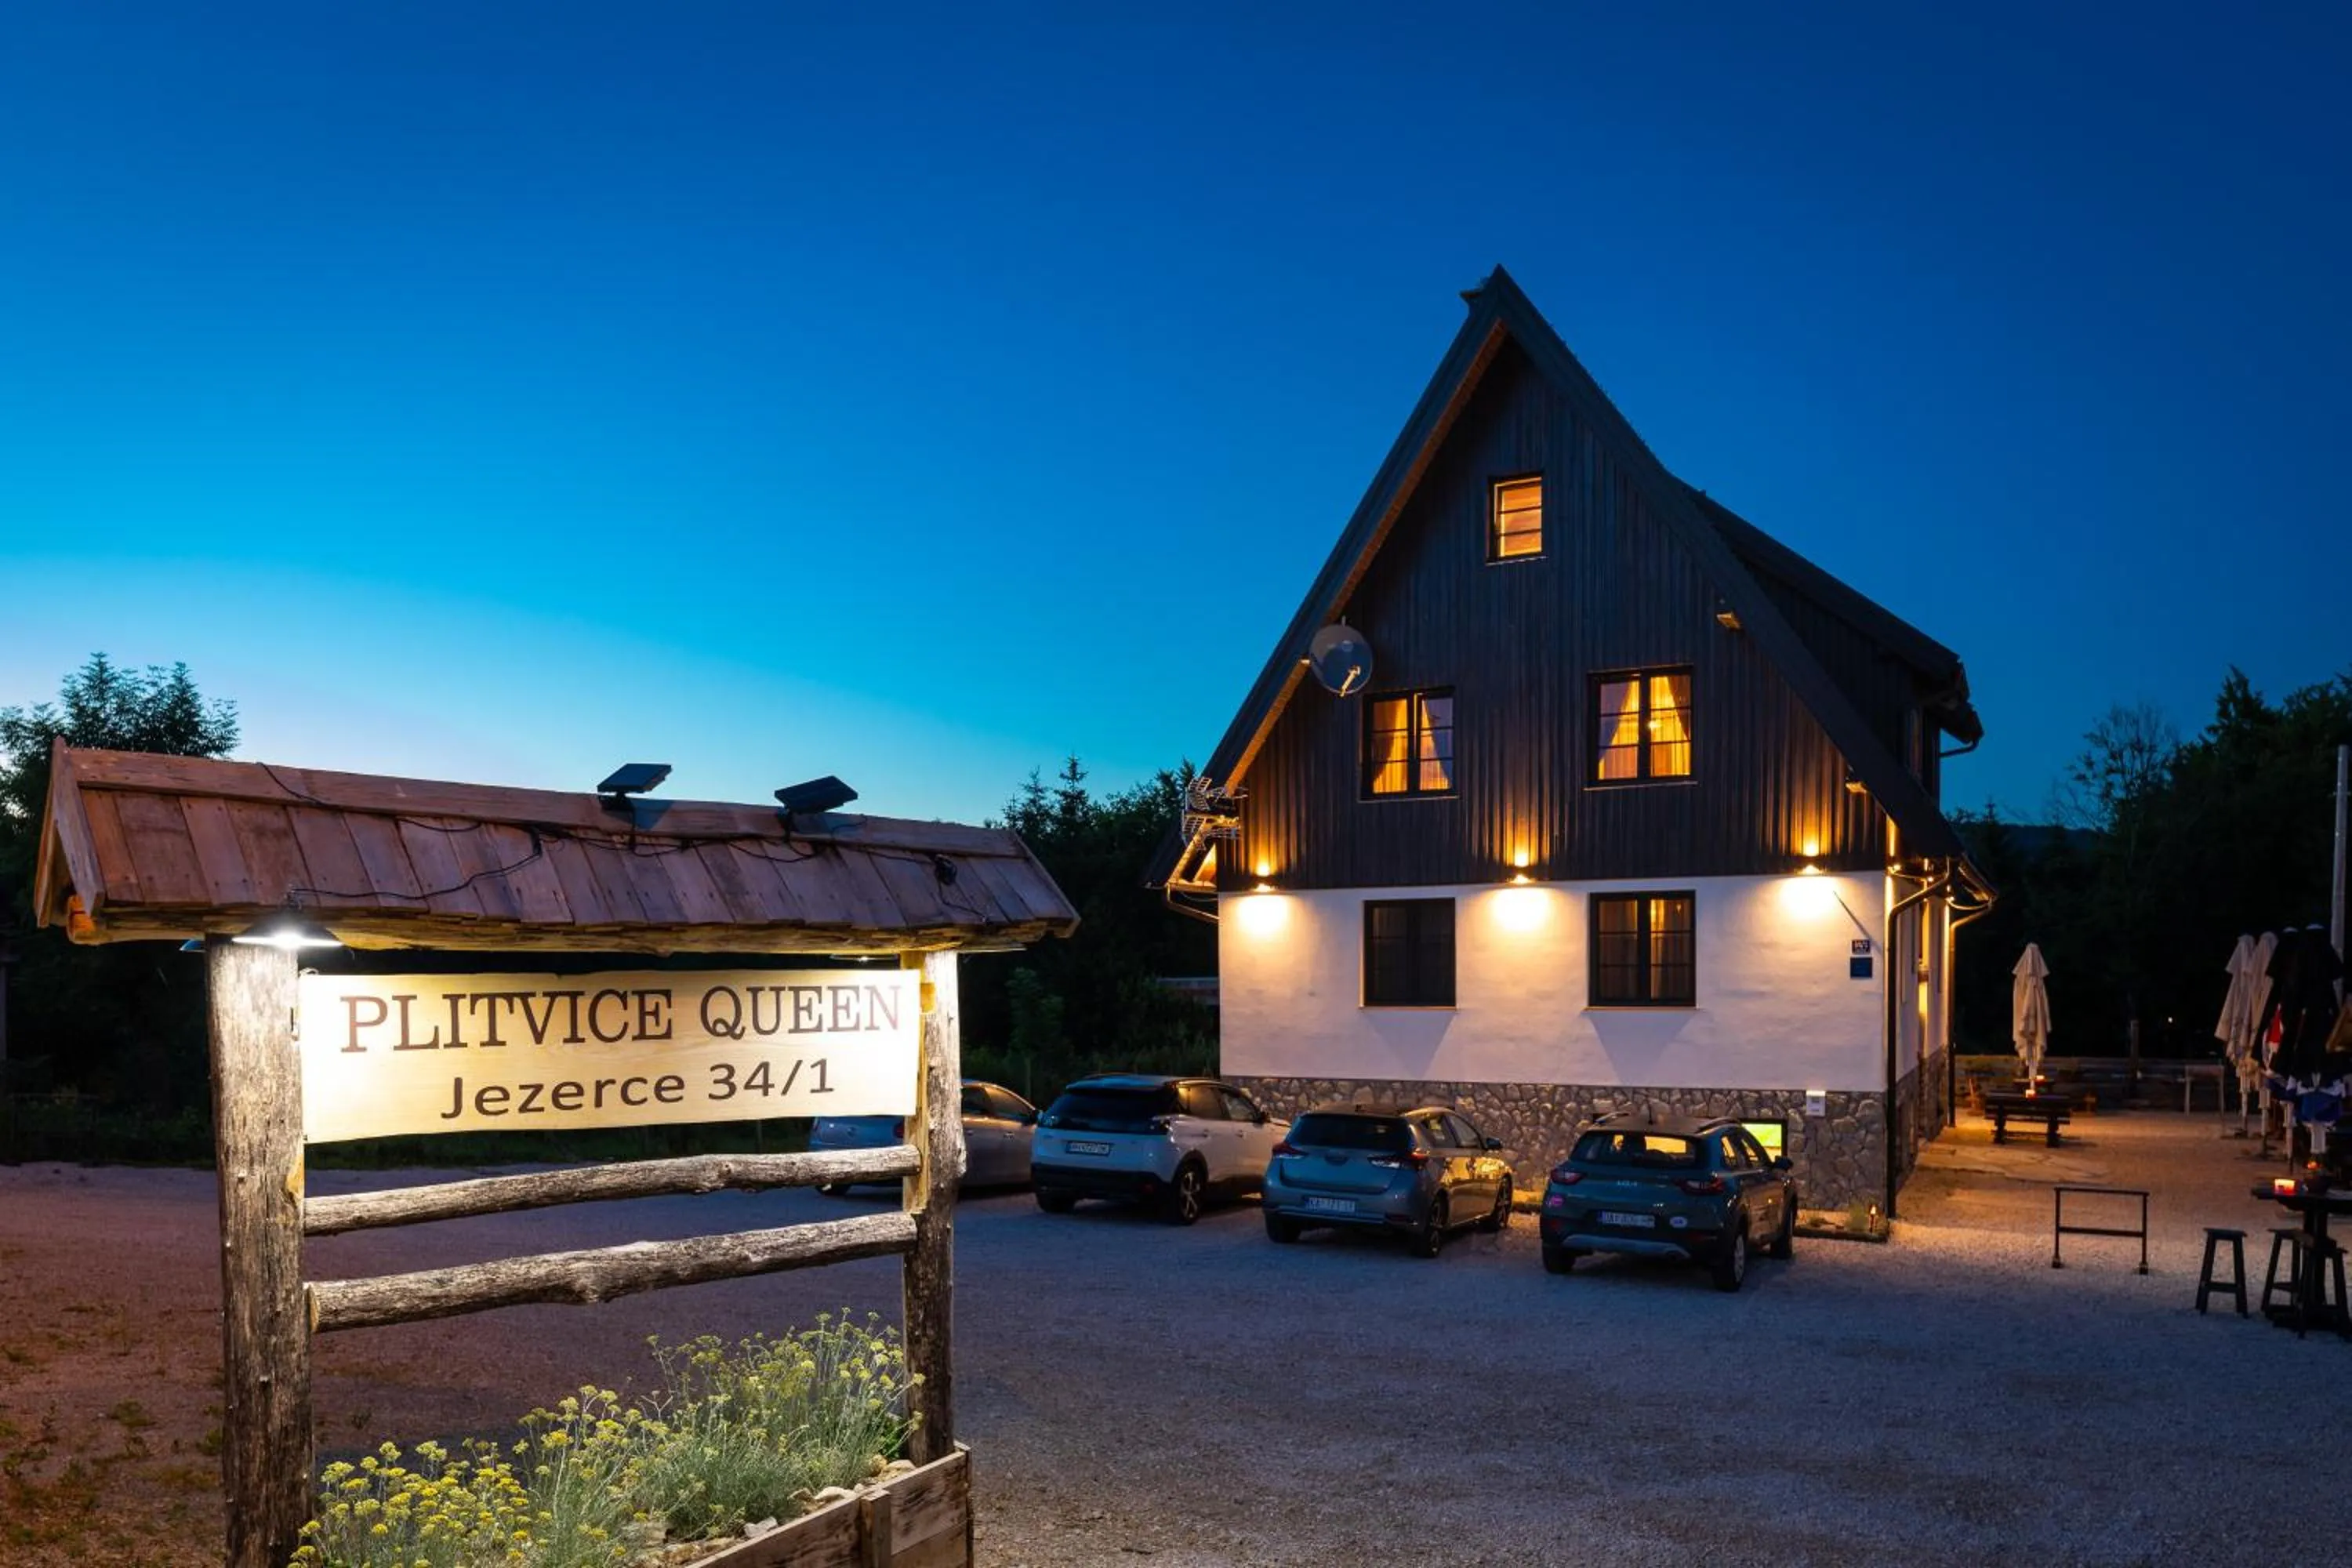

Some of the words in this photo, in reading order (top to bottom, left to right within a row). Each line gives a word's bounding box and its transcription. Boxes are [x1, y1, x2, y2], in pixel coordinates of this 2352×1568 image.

[339, 988, 673, 1053] PLITVICE
[699, 985, 901, 1041] QUEEN
[441, 1074, 685, 1120] Jezerce
[708, 1058, 836, 1100] 34/1
